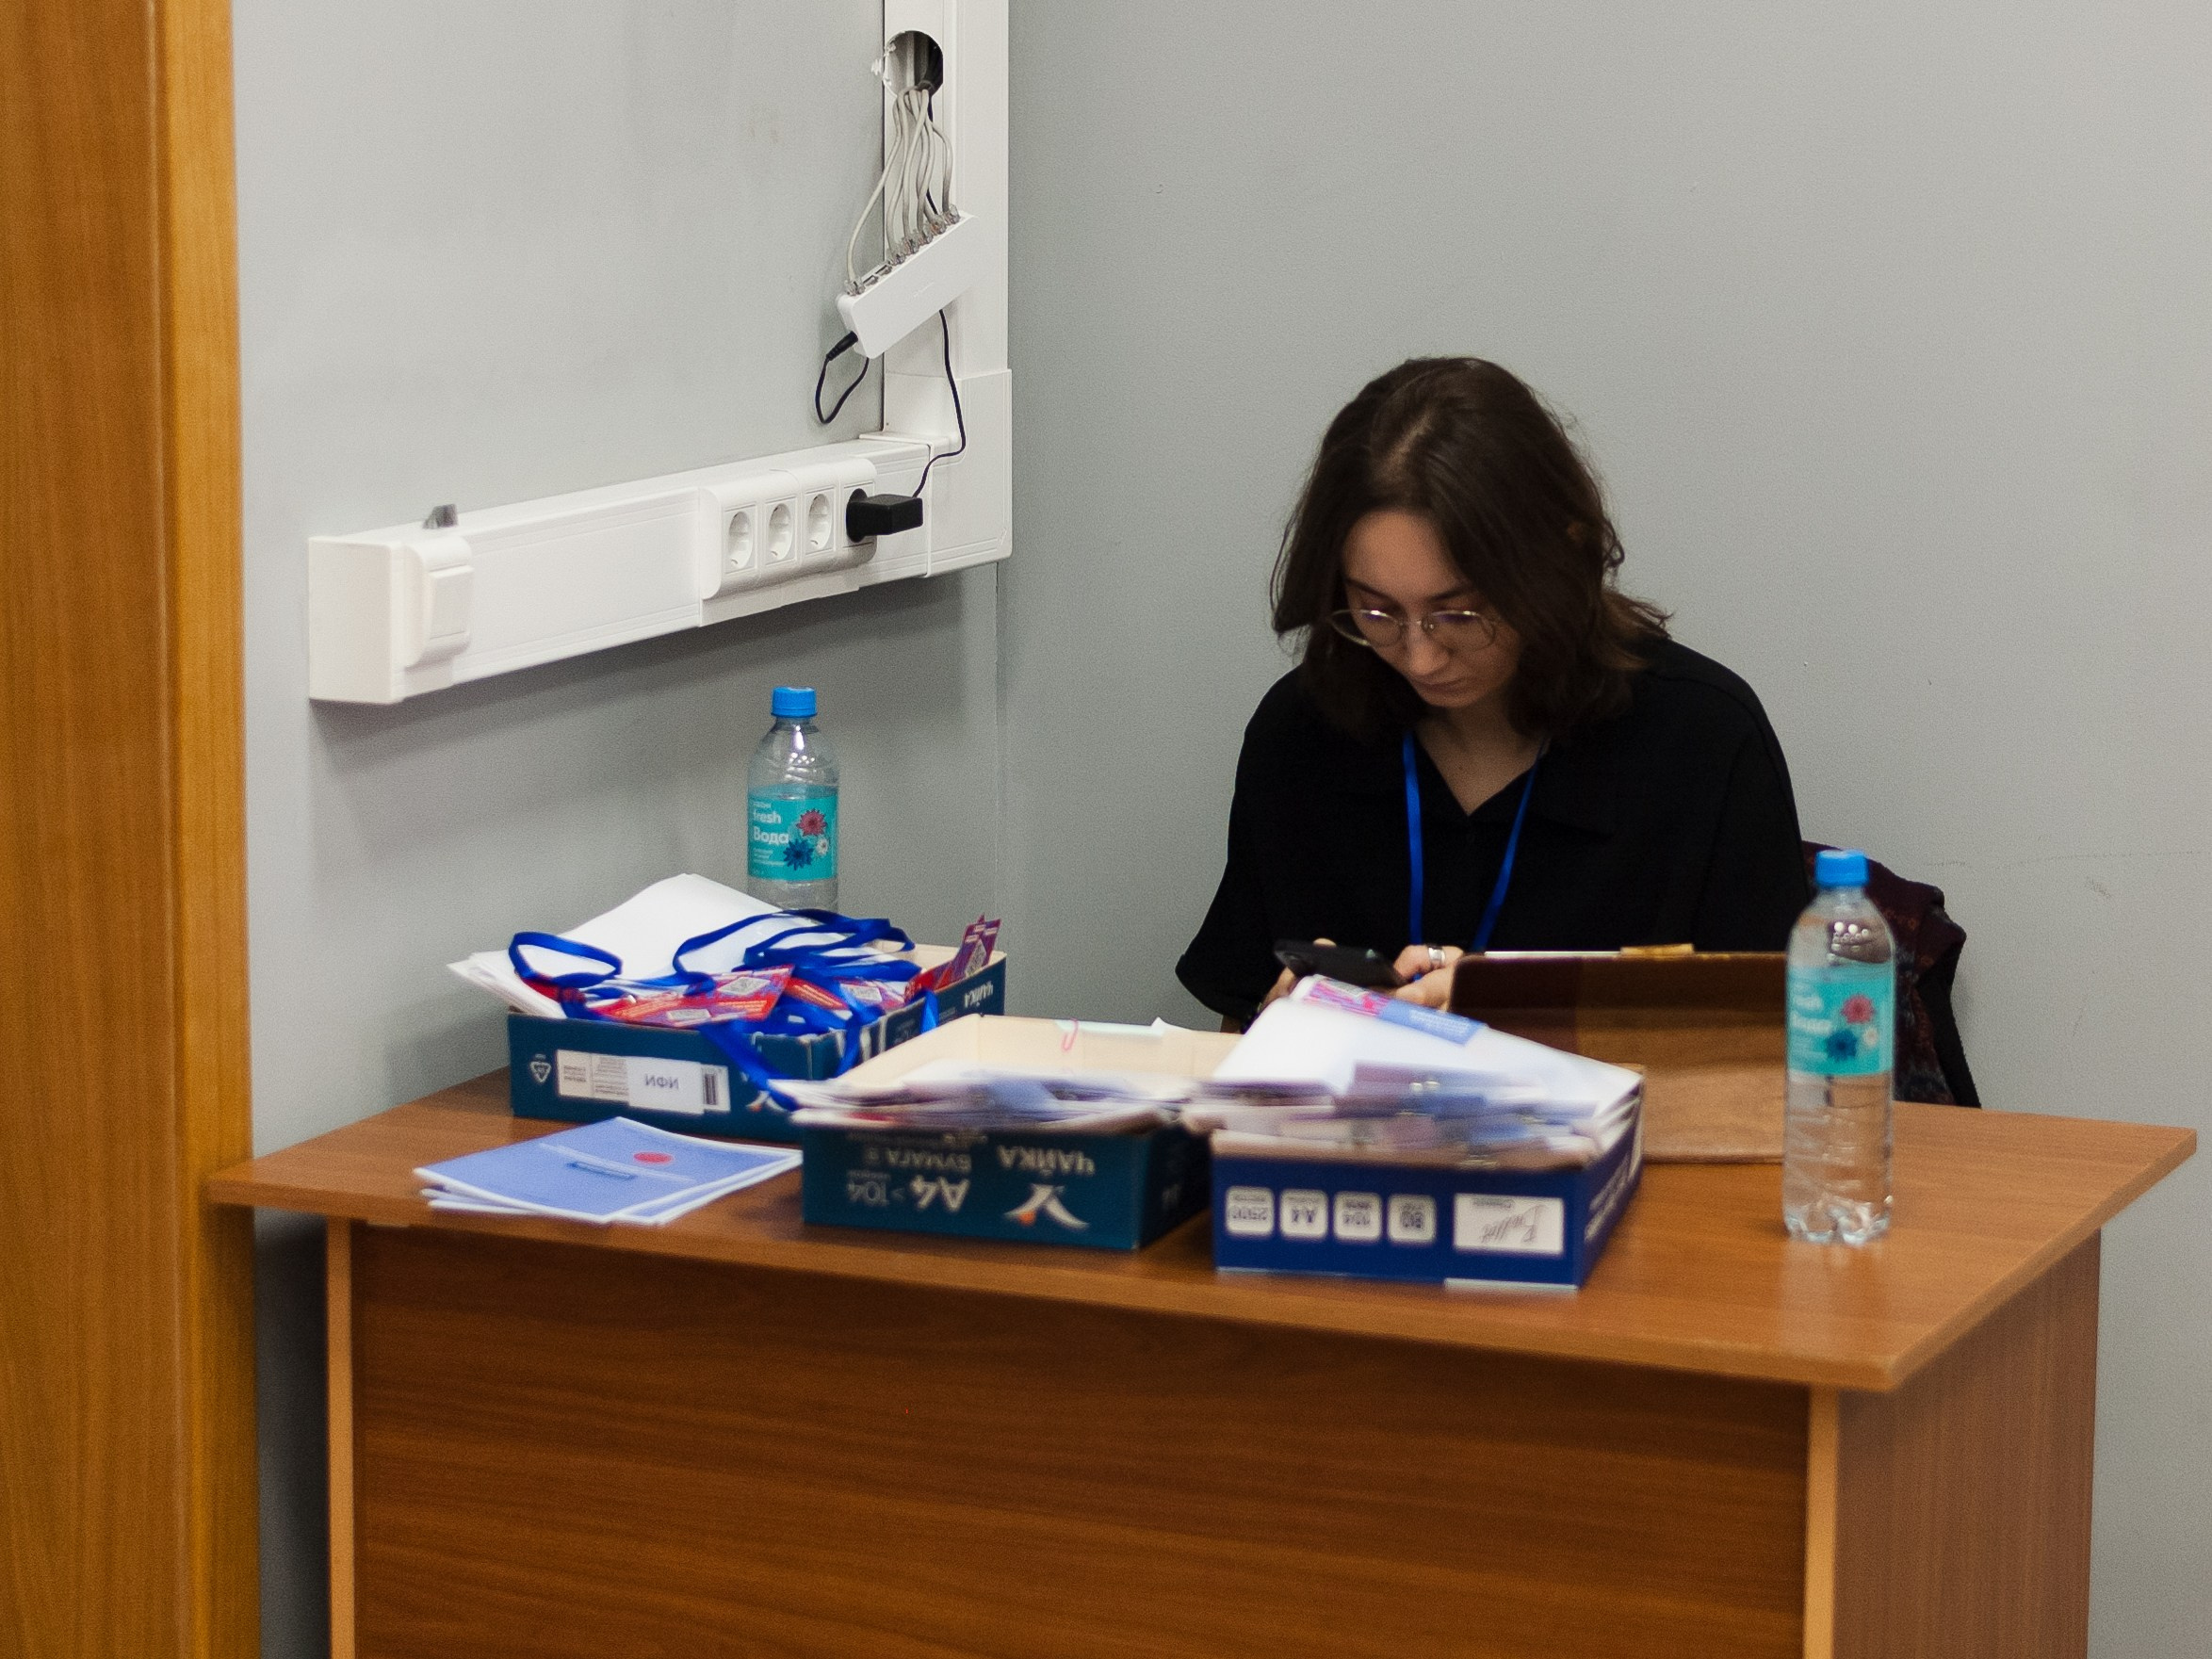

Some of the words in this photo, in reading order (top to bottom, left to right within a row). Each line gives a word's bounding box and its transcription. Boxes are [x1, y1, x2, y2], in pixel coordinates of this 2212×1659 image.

[753, 825, 789, 845] Вода
[643, 1073, 679, 1091] ИФИ
[996, 1145, 1096, 1179] ЧАЙКА
